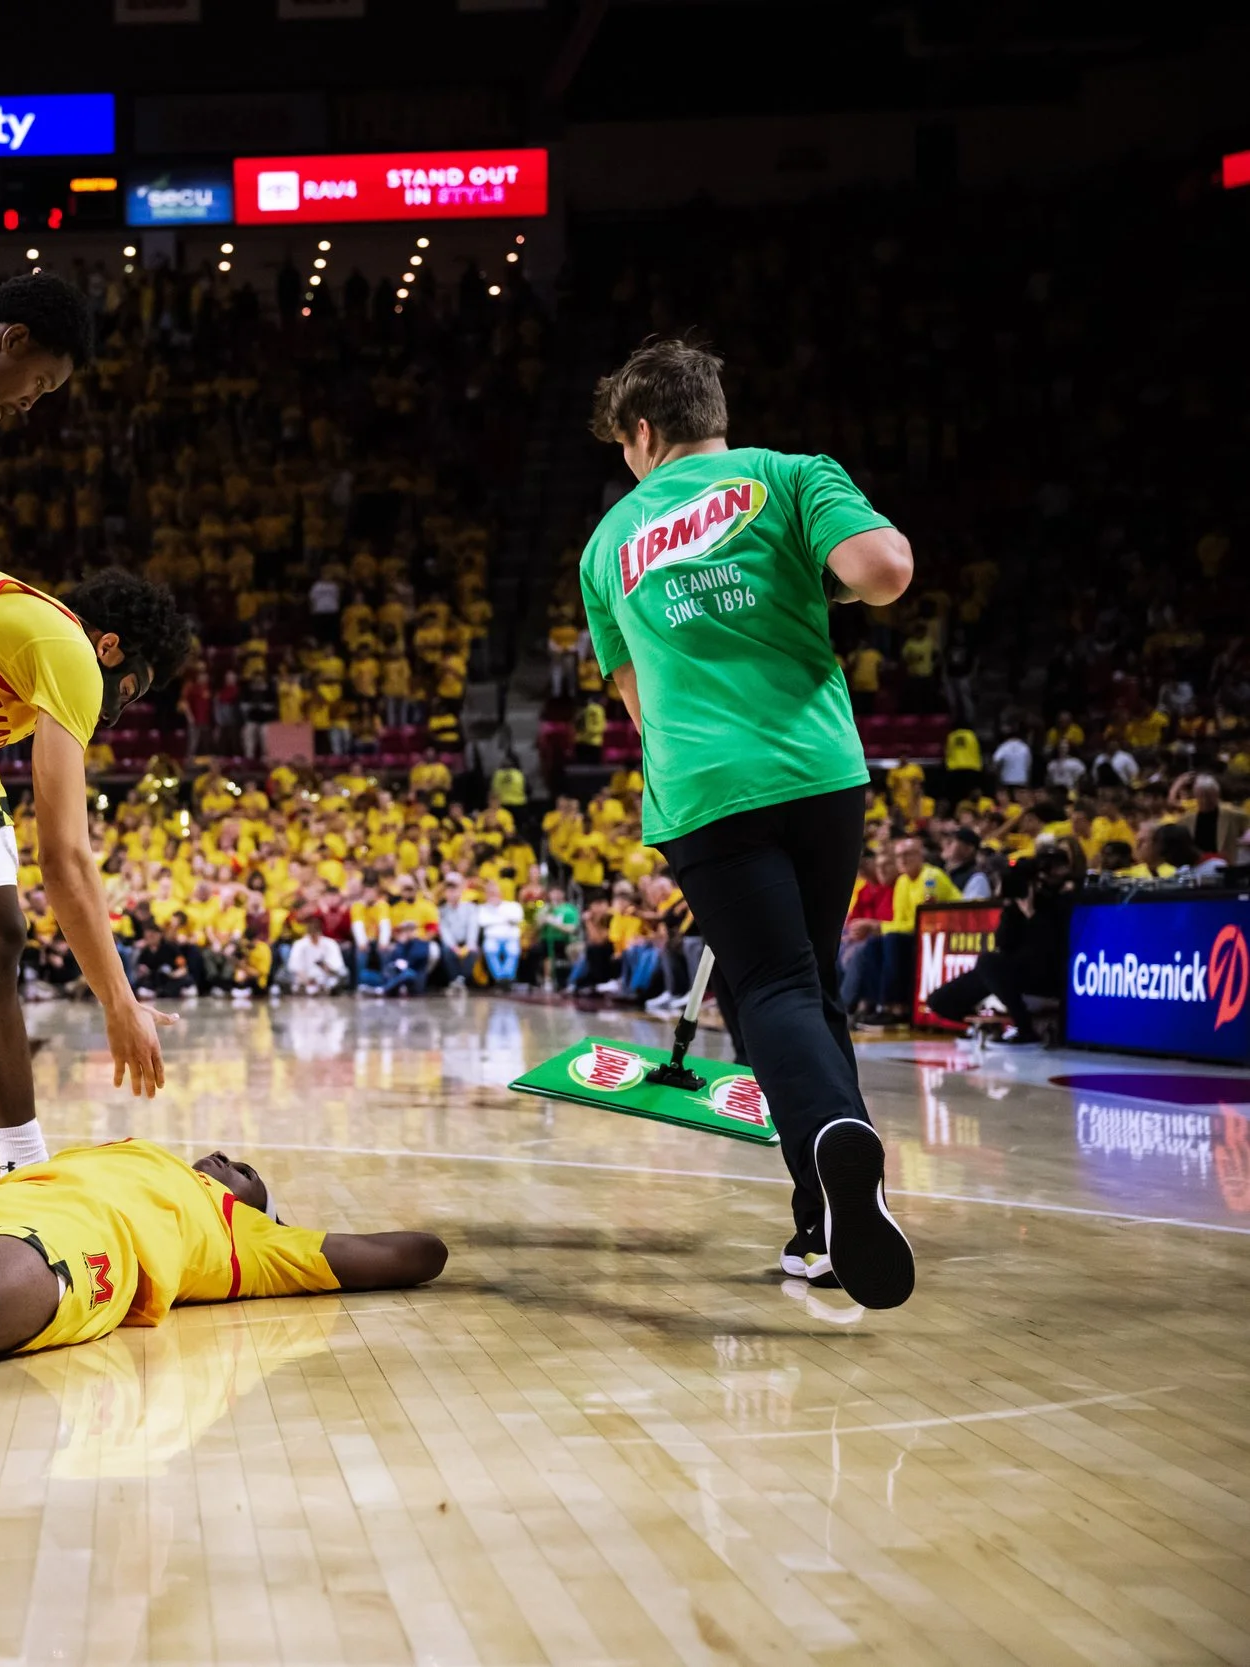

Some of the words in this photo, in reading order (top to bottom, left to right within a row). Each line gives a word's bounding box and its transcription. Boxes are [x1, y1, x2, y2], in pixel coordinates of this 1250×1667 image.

[303, 180, 357, 200] RAV4
[386, 167, 464, 188] STAND
[468, 166, 518, 186] OUT
[404, 188, 431, 205] IN
[437, 186, 504, 204] STYLE
[620, 484, 751, 596] LIBMAN
[665, 563, 742, 600] CLEANING
[665, 597, 705, 628] SINCE
[713, 586, 756, 614] 1896
[1073, 949, 1207, 1002] CohnReznick
[587, 1045, 639, 1089] LIBMAN
